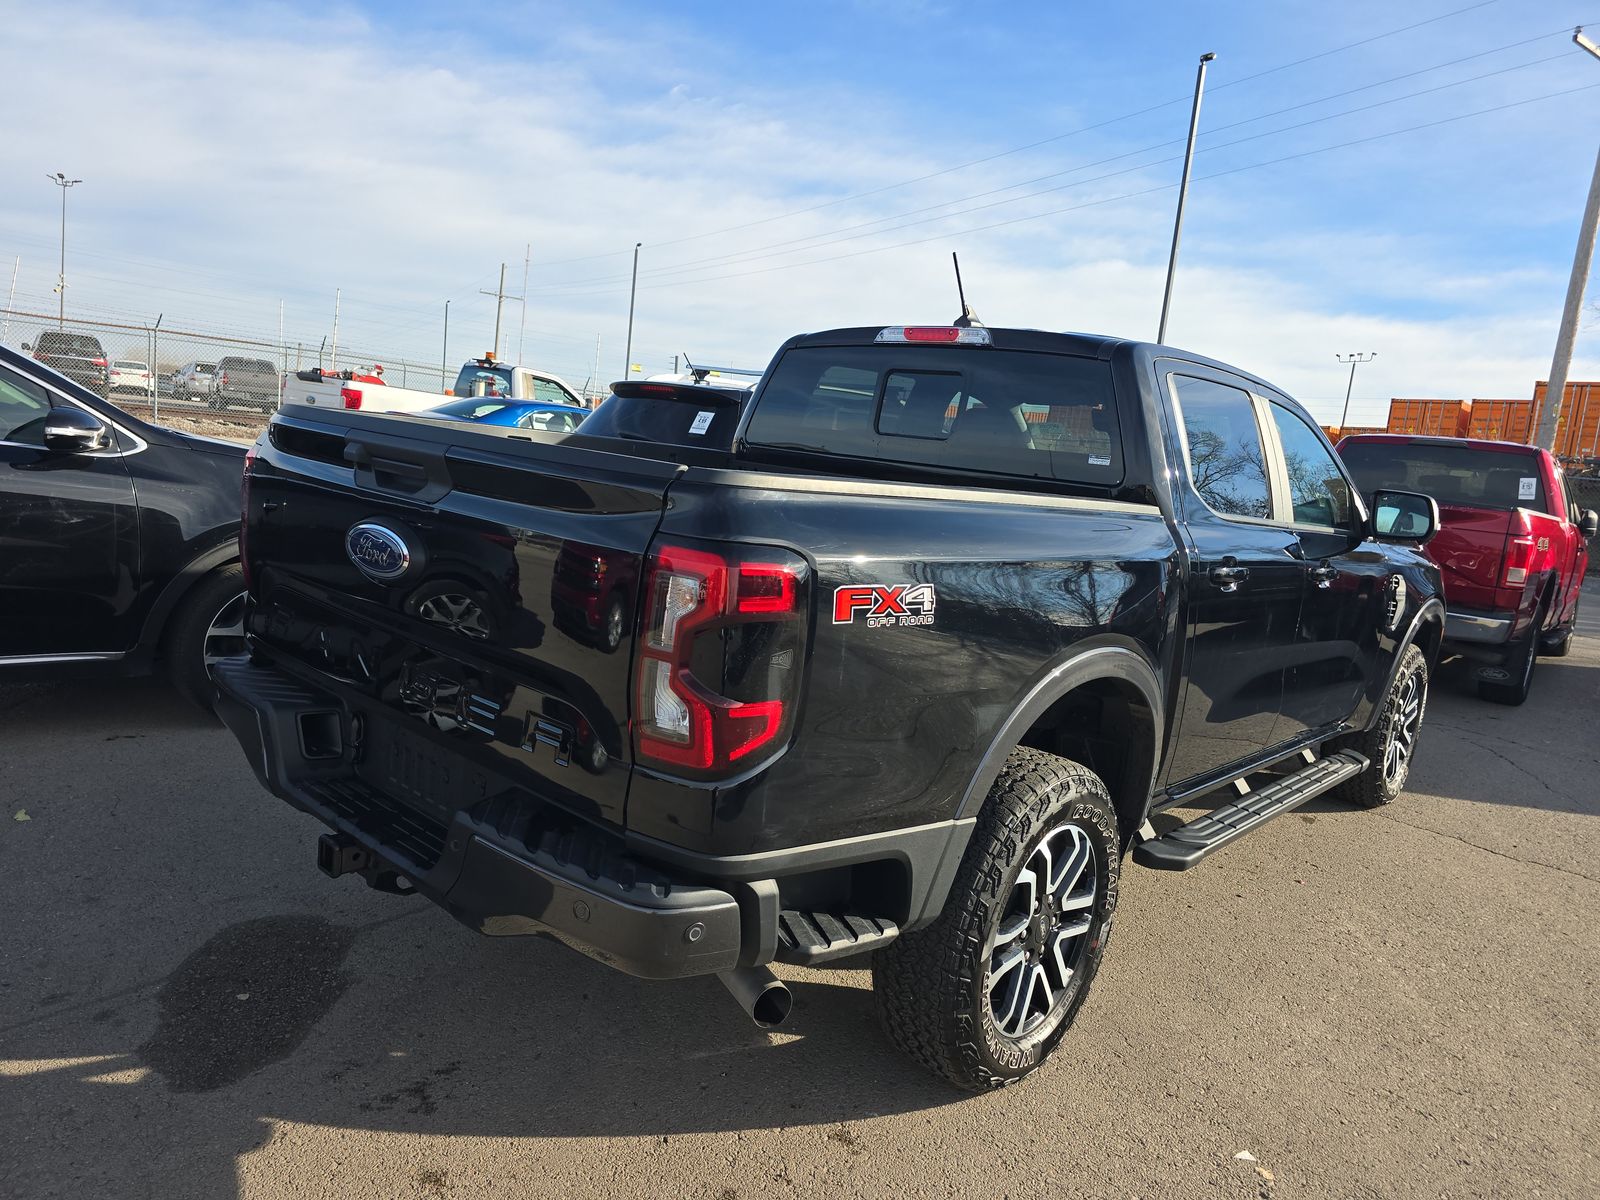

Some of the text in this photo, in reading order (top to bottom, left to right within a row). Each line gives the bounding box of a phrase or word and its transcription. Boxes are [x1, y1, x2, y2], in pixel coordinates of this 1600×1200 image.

[356, 533, 391, 567] Ford
[833, 584, 936, 624] FX4
[867, 615, 935, 628] OFF ROAD
[1073, 803, 1118, 911] GOODYEAR
